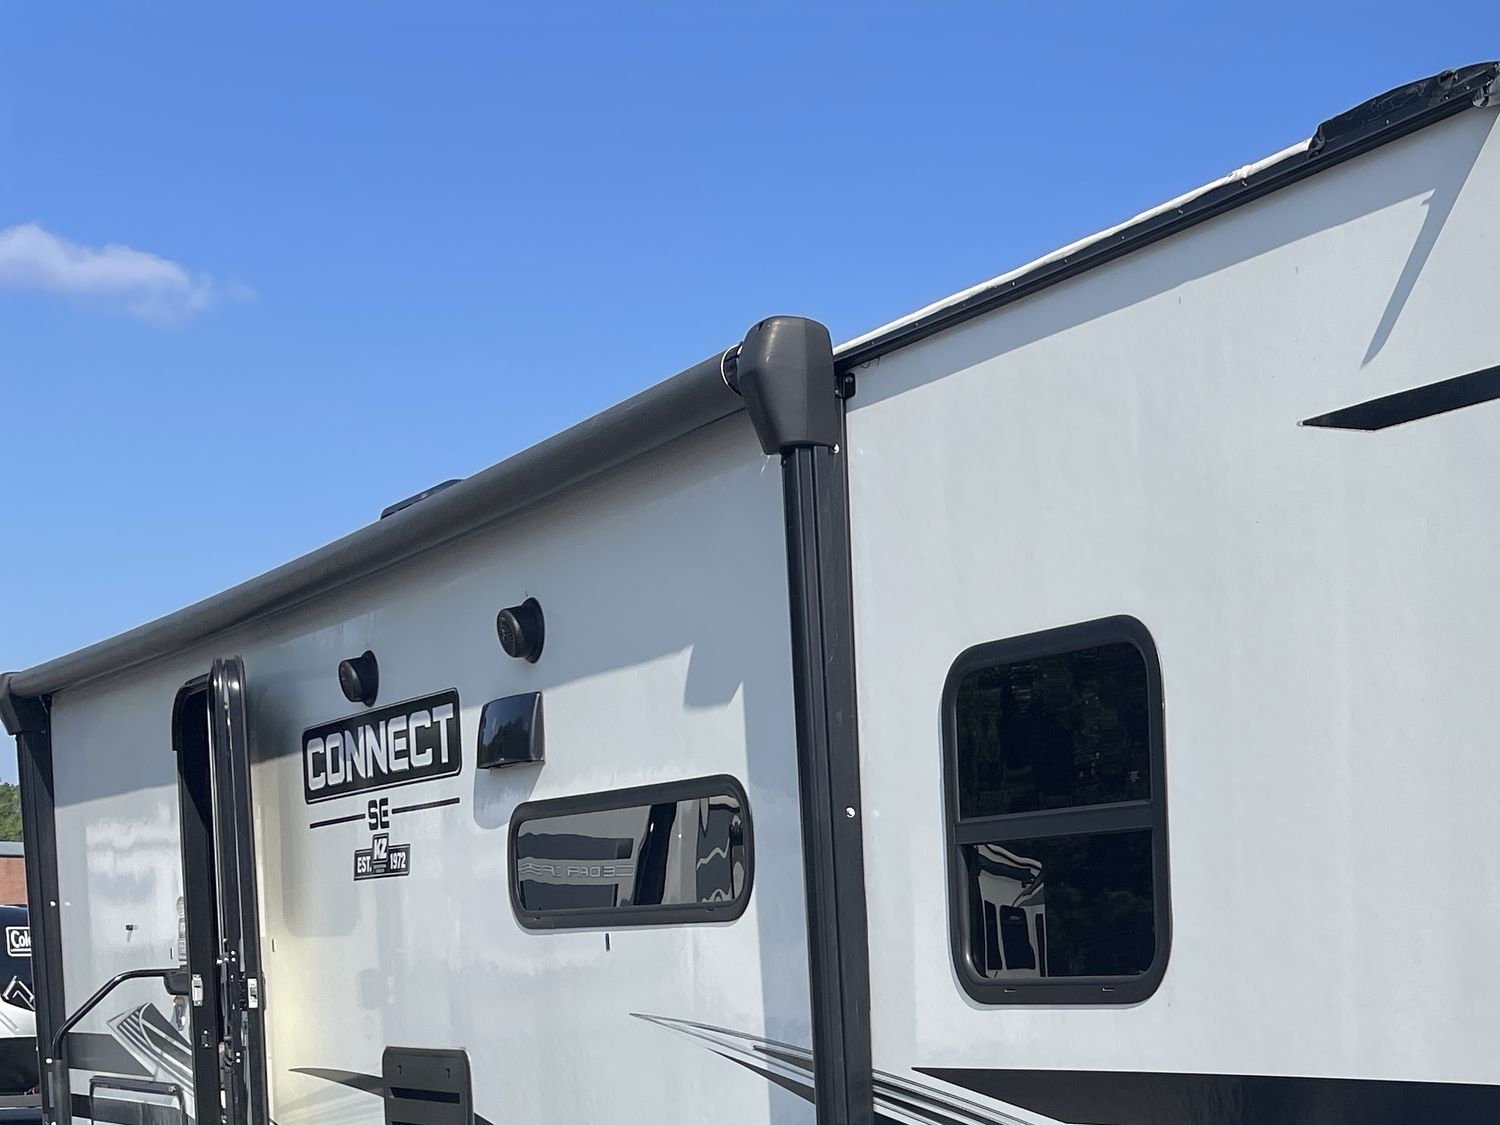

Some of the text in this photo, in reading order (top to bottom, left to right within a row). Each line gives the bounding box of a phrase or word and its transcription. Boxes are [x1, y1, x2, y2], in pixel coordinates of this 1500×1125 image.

[305, 702, 455, 792] CONNECT
[367, 797, 390, 831] SE
[357, 856, 372, 874] EST.
[390, 851, 406, 870] 1972
[373, 838, 388, 860] KZ
